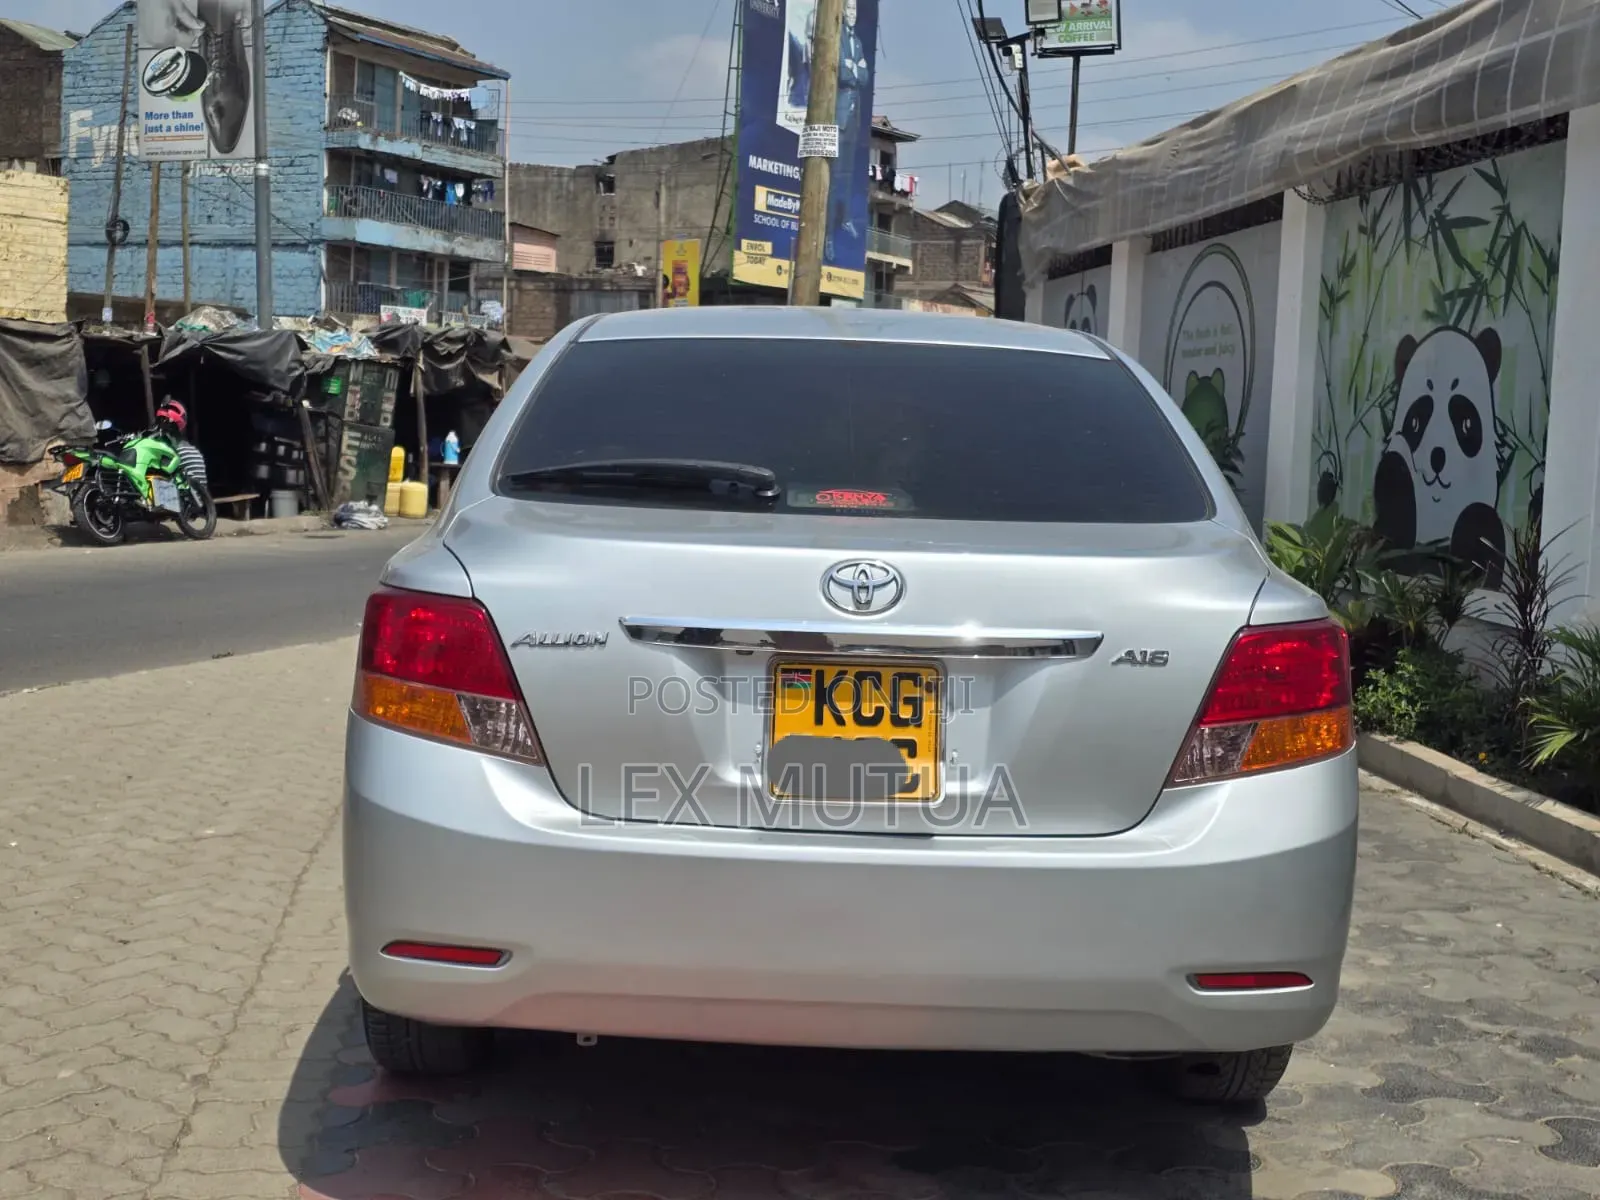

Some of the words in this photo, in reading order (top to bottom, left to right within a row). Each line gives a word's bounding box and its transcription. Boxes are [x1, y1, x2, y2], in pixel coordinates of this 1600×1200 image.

[1068, 21, 1113, 31] ARRIVAL
[1058, 33, 1096, 43] COFFEE
[145, 111, 169, 121] More
[172, 111, 194, 120] than
[144, 124, 163, 135] just
[174, 122, 204, 132] shine!
[510, 630, 610, 649] ALLION
[813, 669, 924, 729] KCG
